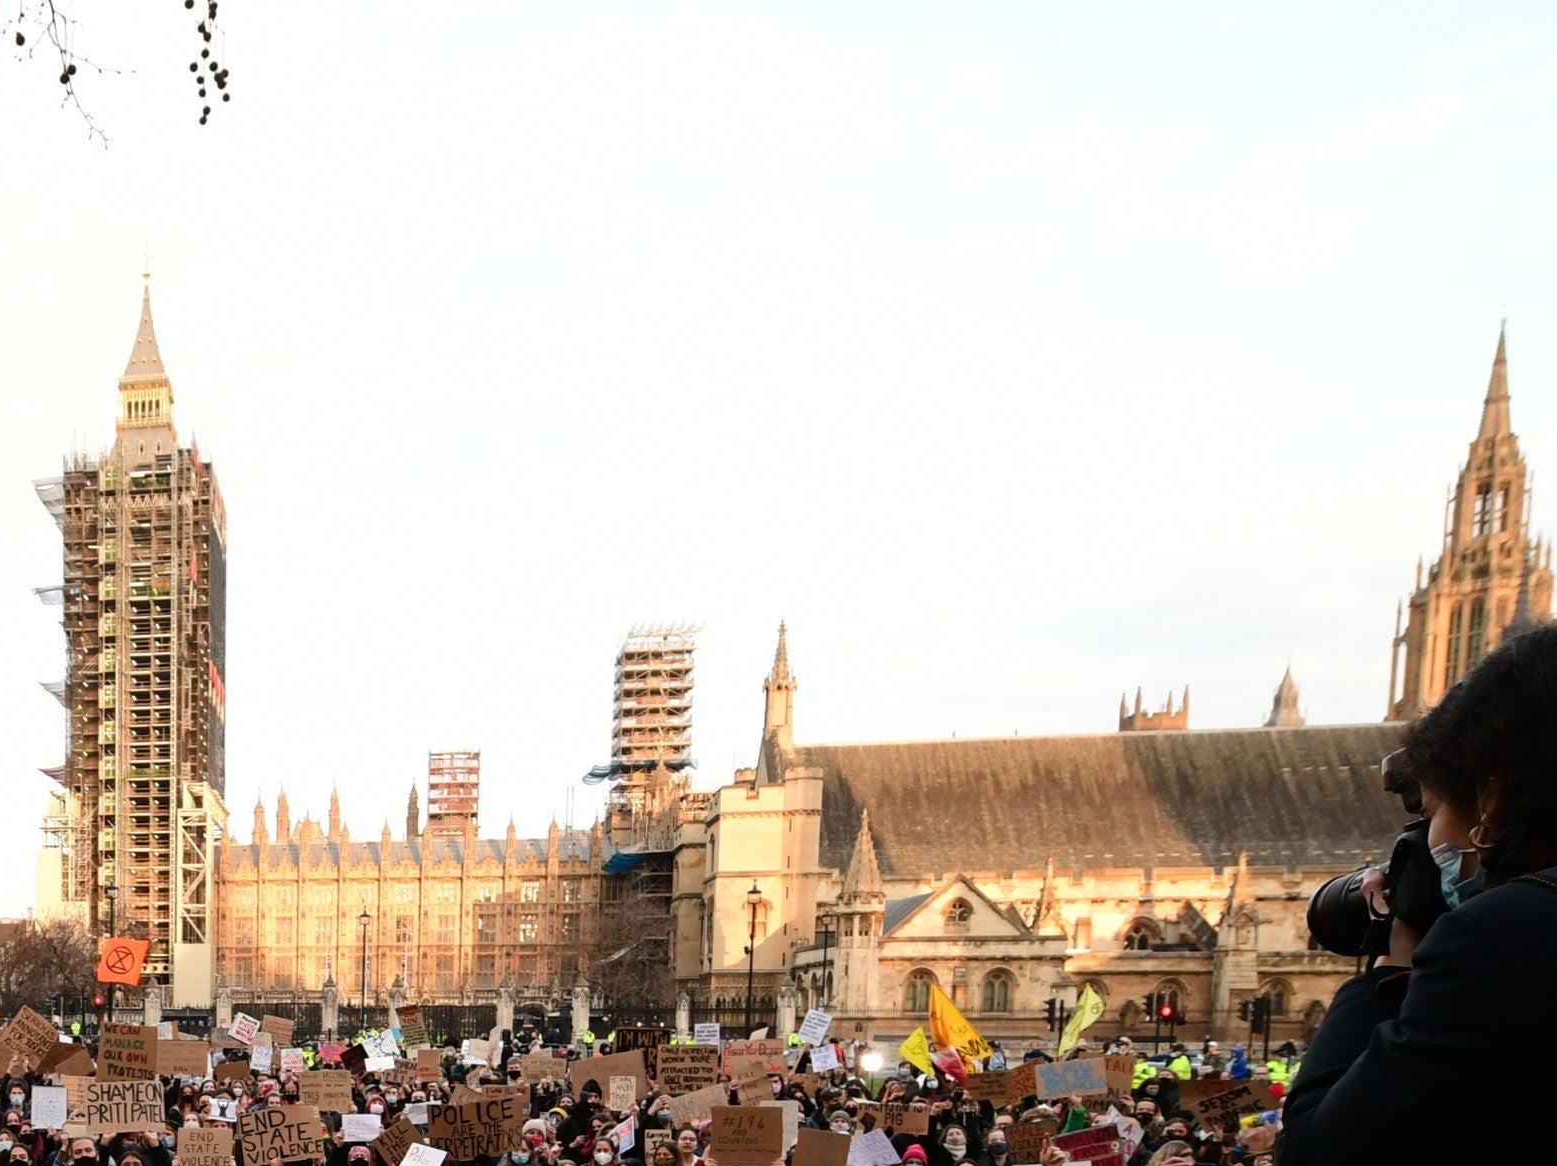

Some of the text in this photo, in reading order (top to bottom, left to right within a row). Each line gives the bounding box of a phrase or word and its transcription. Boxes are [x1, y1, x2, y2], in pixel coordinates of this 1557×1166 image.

[104, 1023, 141, 1036] WE CAN
[104, 1038, 145, 1050] MANAGE
[104, 1050, 147, 1064] OUR OWN
[108, 1063, 156, 1079] PROTESTS
[701, 1066, 713, 1074] TO
[87, 1082, 144, 1102] SHAME
[145, 1082, 163, 1101] ON
[87, 1102, 128, 1125] PRITI
[130, 1102, 166, 1124] PATEL
[431, 1098, 514, 1125] POLICE
[884, 1111, 904, 1127] PIG
[239, 1109, 286, 1135] END
[452, 1119, 504, 1138] ARE THE
[189, 1131, 215, 1142] END
[242, 1121, 312, 1152] STATE
[380, 1124, 408, 1147] KILL
[430, 1125, 523, 1158] PERPETRATORS
[718, 1136, 760, 1145] COUNTING
[184, 1143, 220, 1154] STATE
[246, 1140, 324, 1164] VIOLENCE
[386, 1137, 408, 1154] THE
